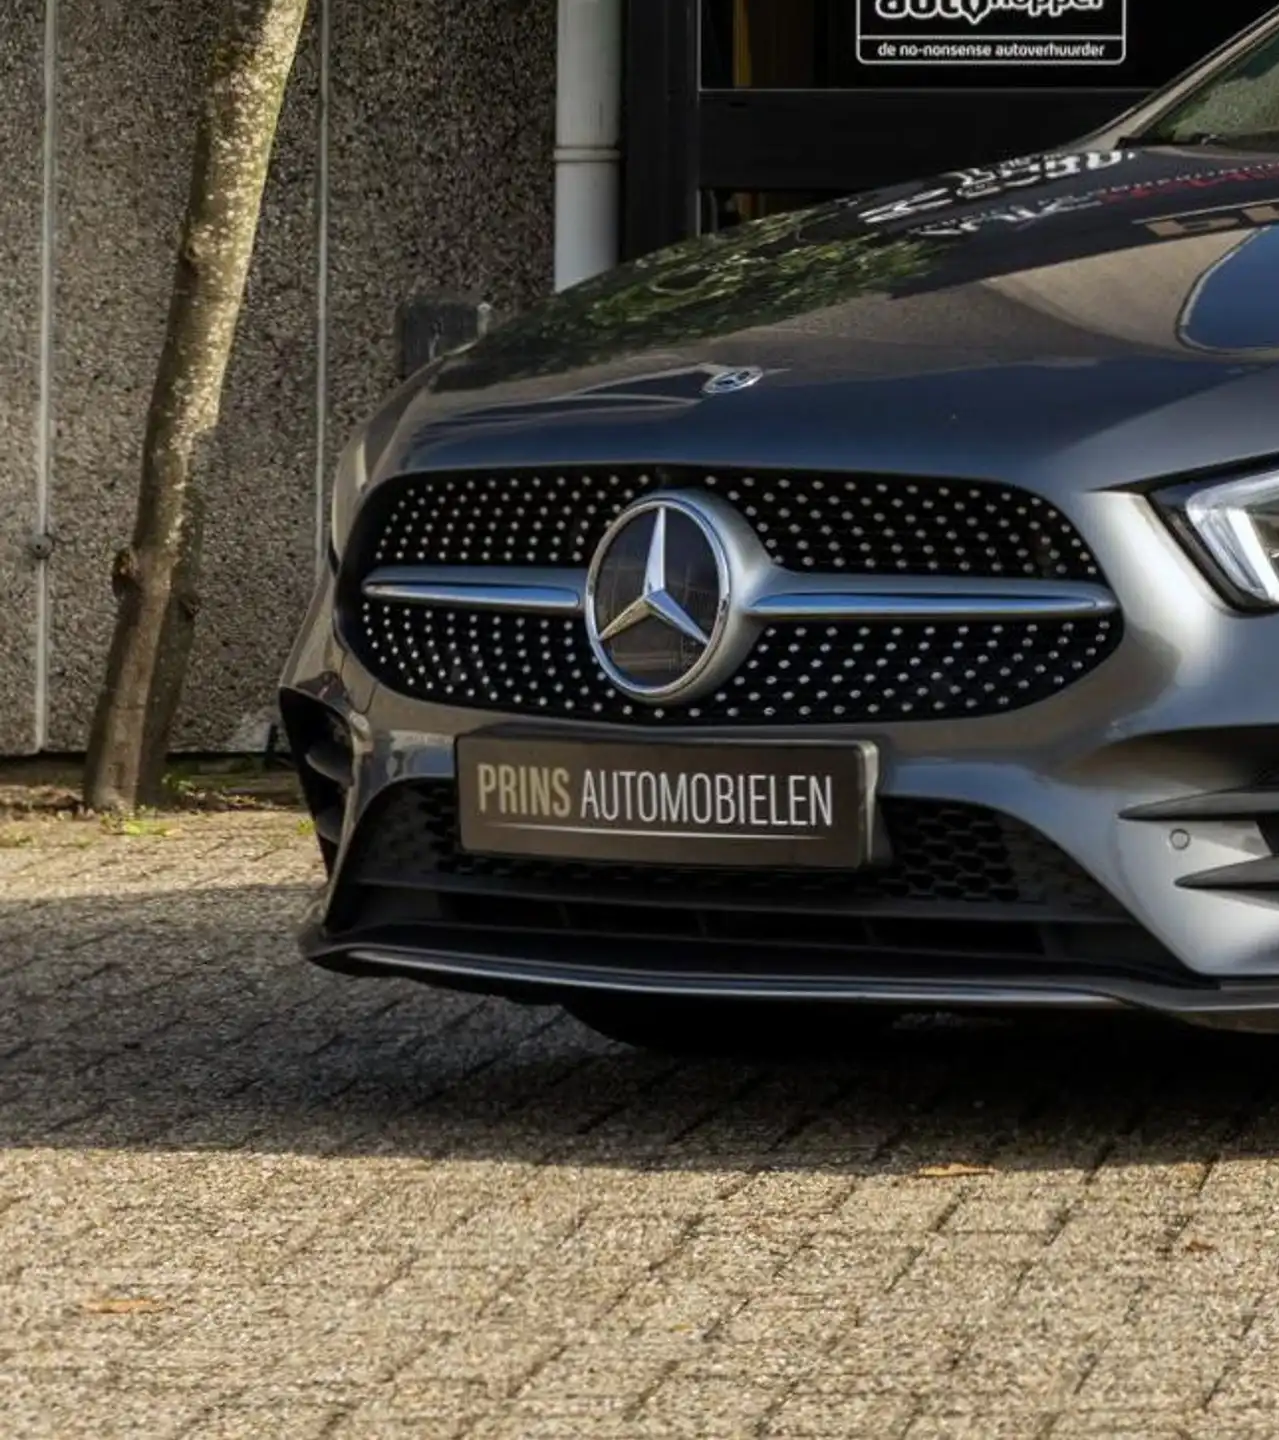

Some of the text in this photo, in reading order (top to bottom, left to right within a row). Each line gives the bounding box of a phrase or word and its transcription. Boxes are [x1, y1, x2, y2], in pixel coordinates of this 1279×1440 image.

[877, 42, 1105, 57] de no-nonsense autoverhuurder
[476, 763, 833, 827] PRINS AUTOMOBIELEN
